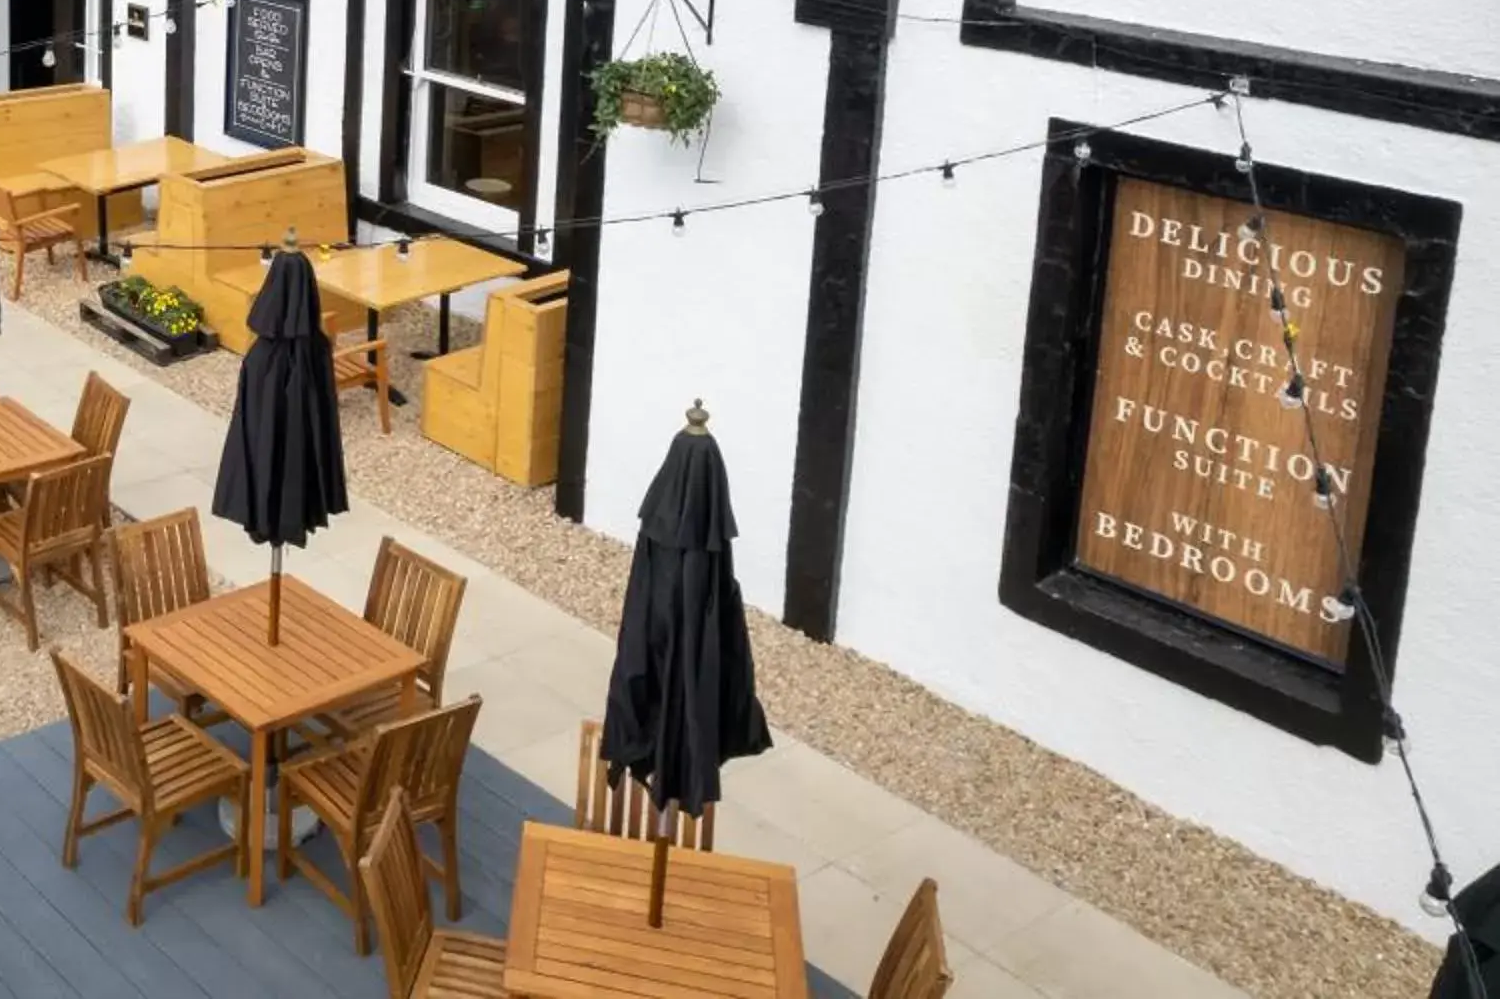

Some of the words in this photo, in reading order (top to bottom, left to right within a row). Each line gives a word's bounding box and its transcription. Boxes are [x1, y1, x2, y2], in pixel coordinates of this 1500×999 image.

[1129, 211, 1383, 294] DELICIOUS
[1124, 336, 1144, 358] &
[1159, 347, 1358, 420] COCKTILS
[1114, 396, 1352, 494] FUNCTION
[1173, 450, 1276, 501] SUITE
[1095, 512, 1340, 623] BEDROOMS
[1171, 511, 1266, 562] WITH
